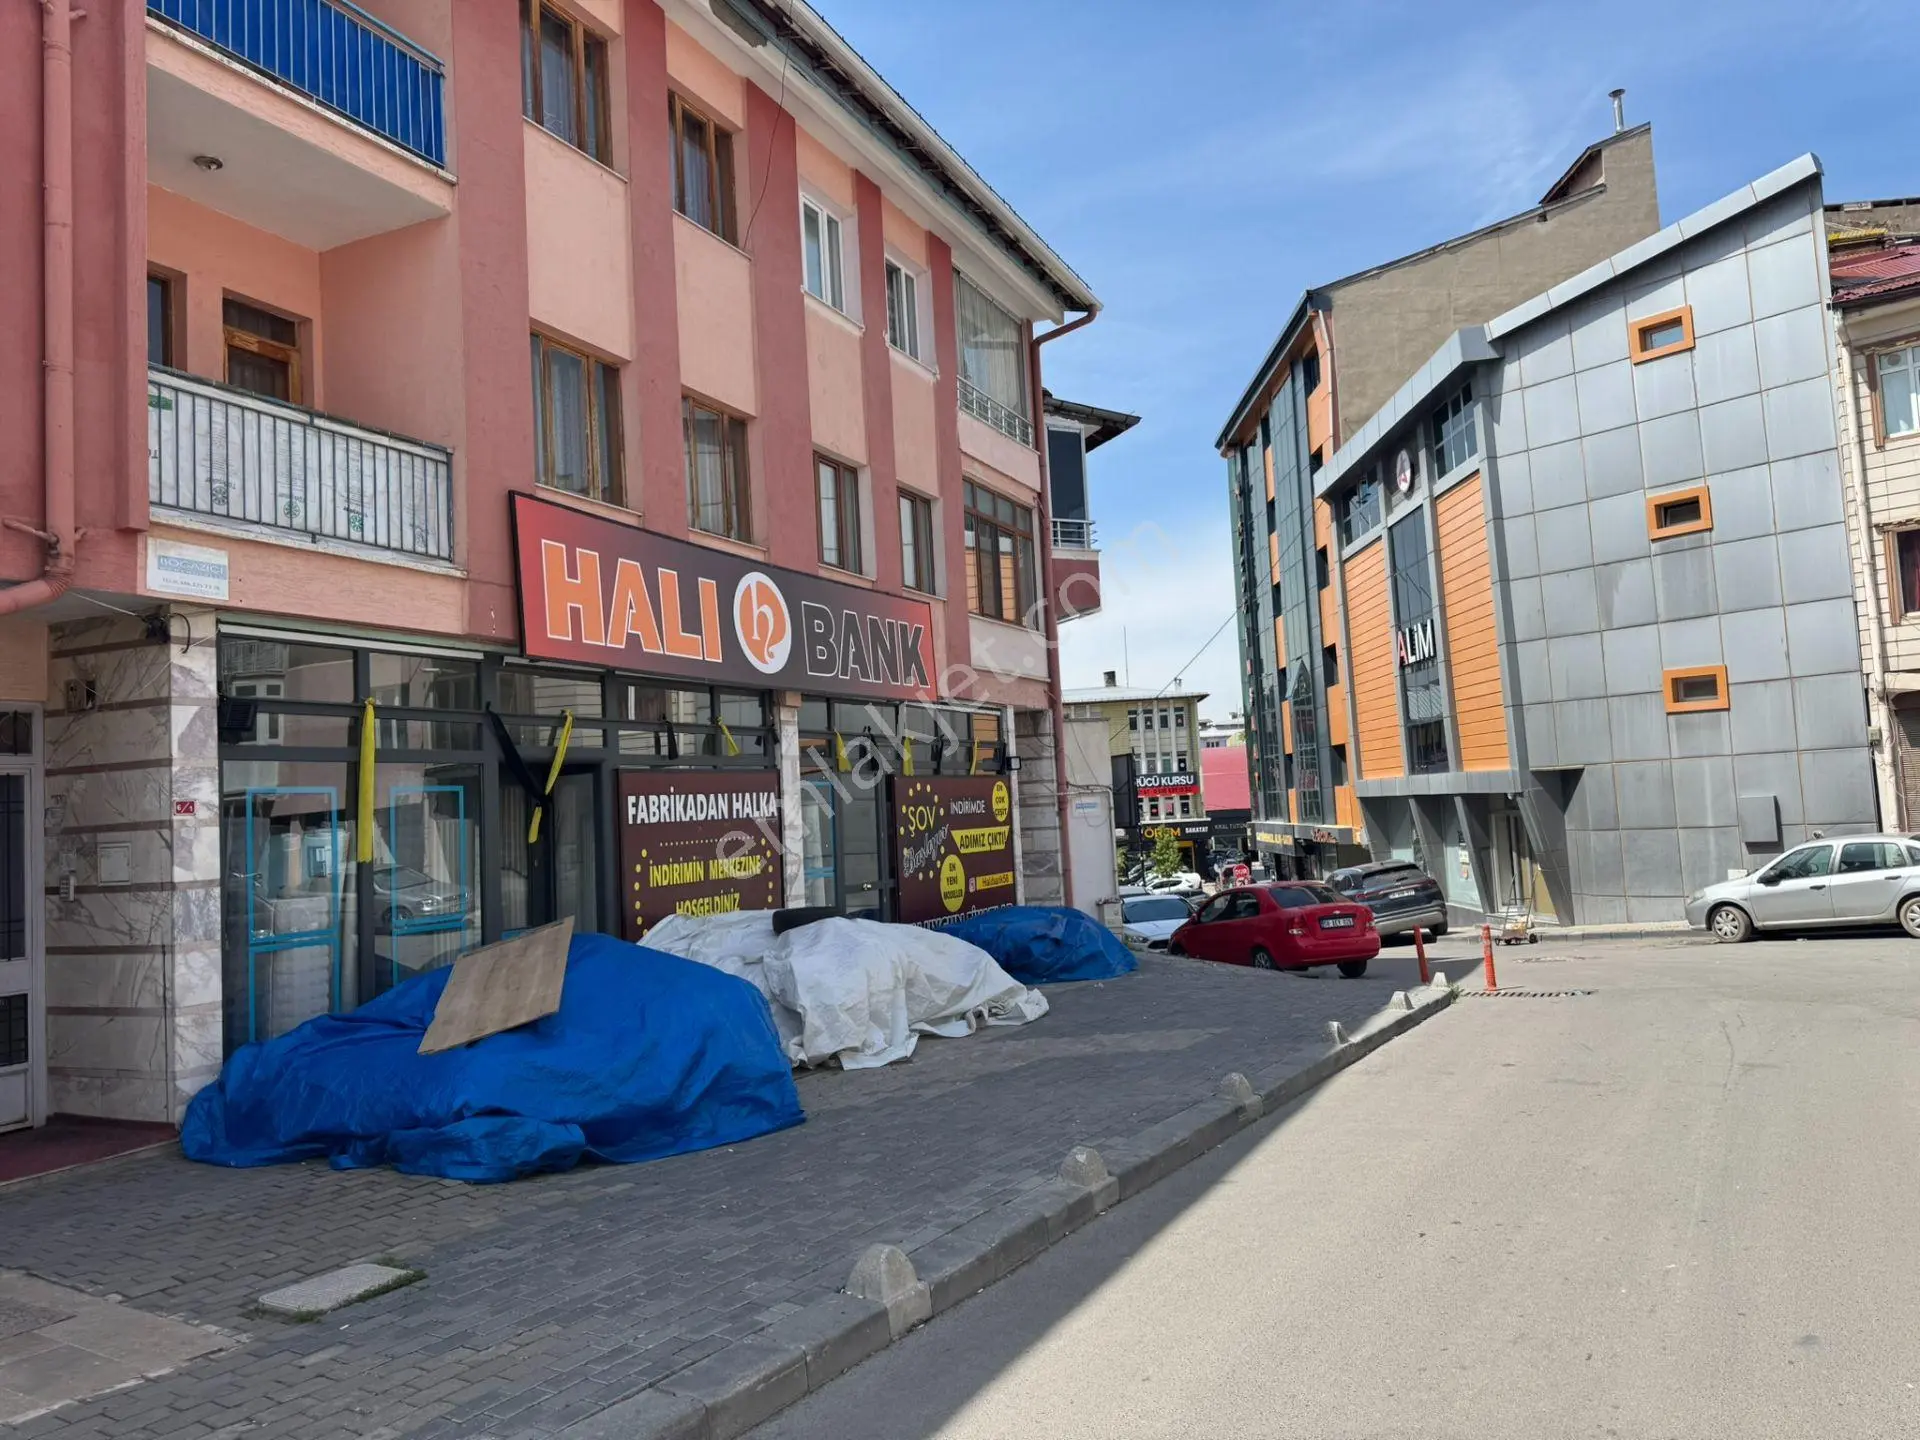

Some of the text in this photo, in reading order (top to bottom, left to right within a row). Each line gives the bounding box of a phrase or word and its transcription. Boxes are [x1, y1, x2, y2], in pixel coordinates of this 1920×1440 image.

[541, 539, 931, 688] HALI BANK
[1161, 774, 1194, 786] KURSU
[627, 786, 778, 825] FABRİKADAN HALKA
[908, 806, 936, 837] ŞOV
[950, 797, 986, 815] İNDİRİMDE
[649, 850, 761, 887] İNDİRİMİN MERKEZİNE
